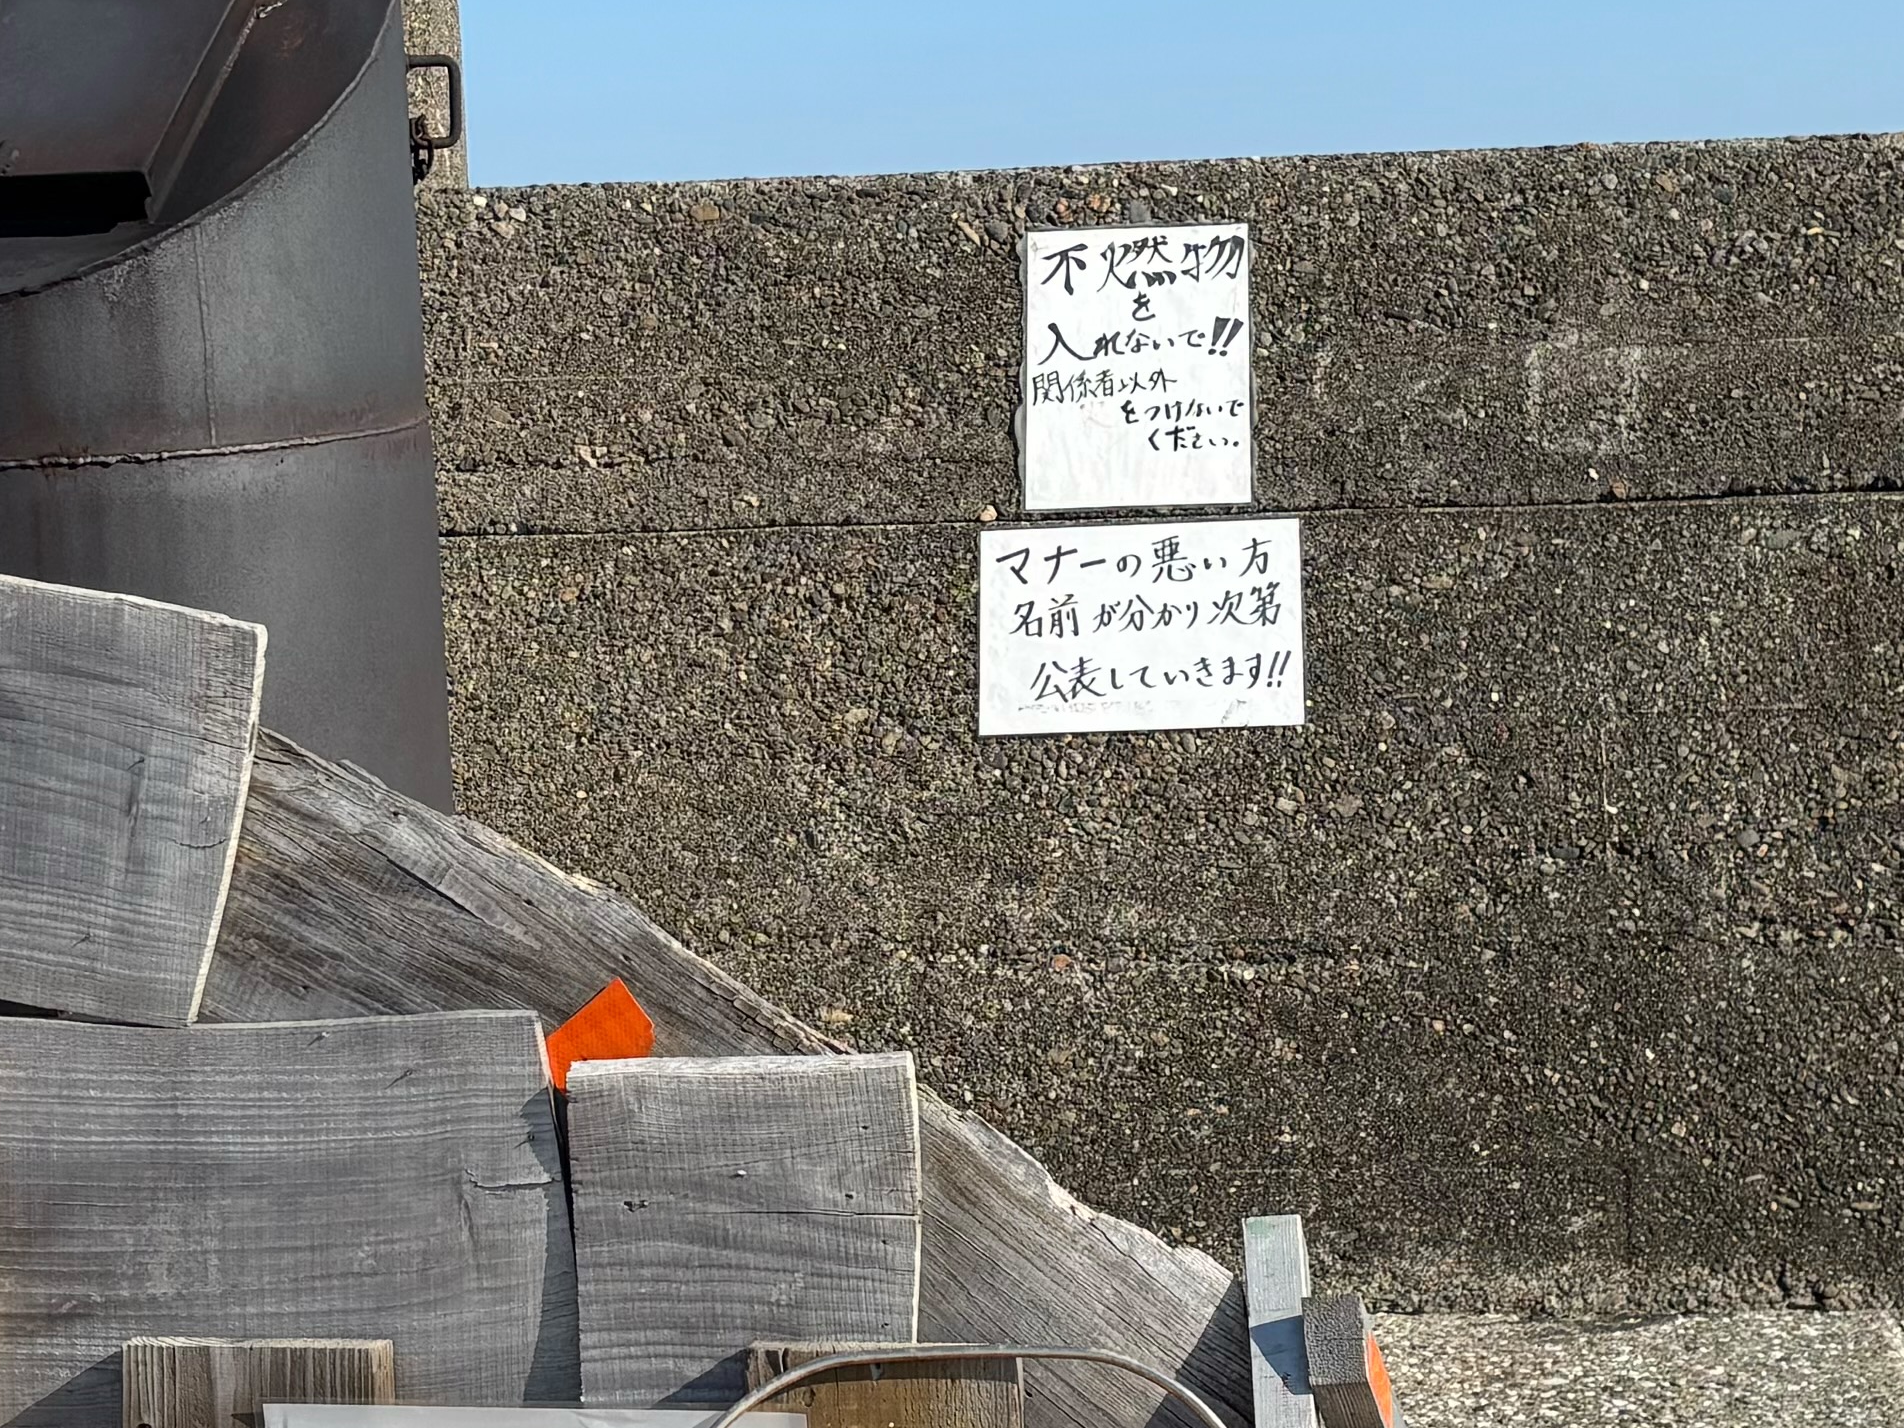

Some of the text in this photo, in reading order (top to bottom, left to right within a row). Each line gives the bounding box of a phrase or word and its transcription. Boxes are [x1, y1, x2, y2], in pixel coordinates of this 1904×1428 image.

[1040, 234, 1245, 294] 不燃物
[1131, 291, 1156, 320] を
[1032, 369, 1178, 407] 関係者以外
[995, 536, 1273, 585] マナーの悪い方
[1010, 581, 1282, 638] 名前が分かり次第
